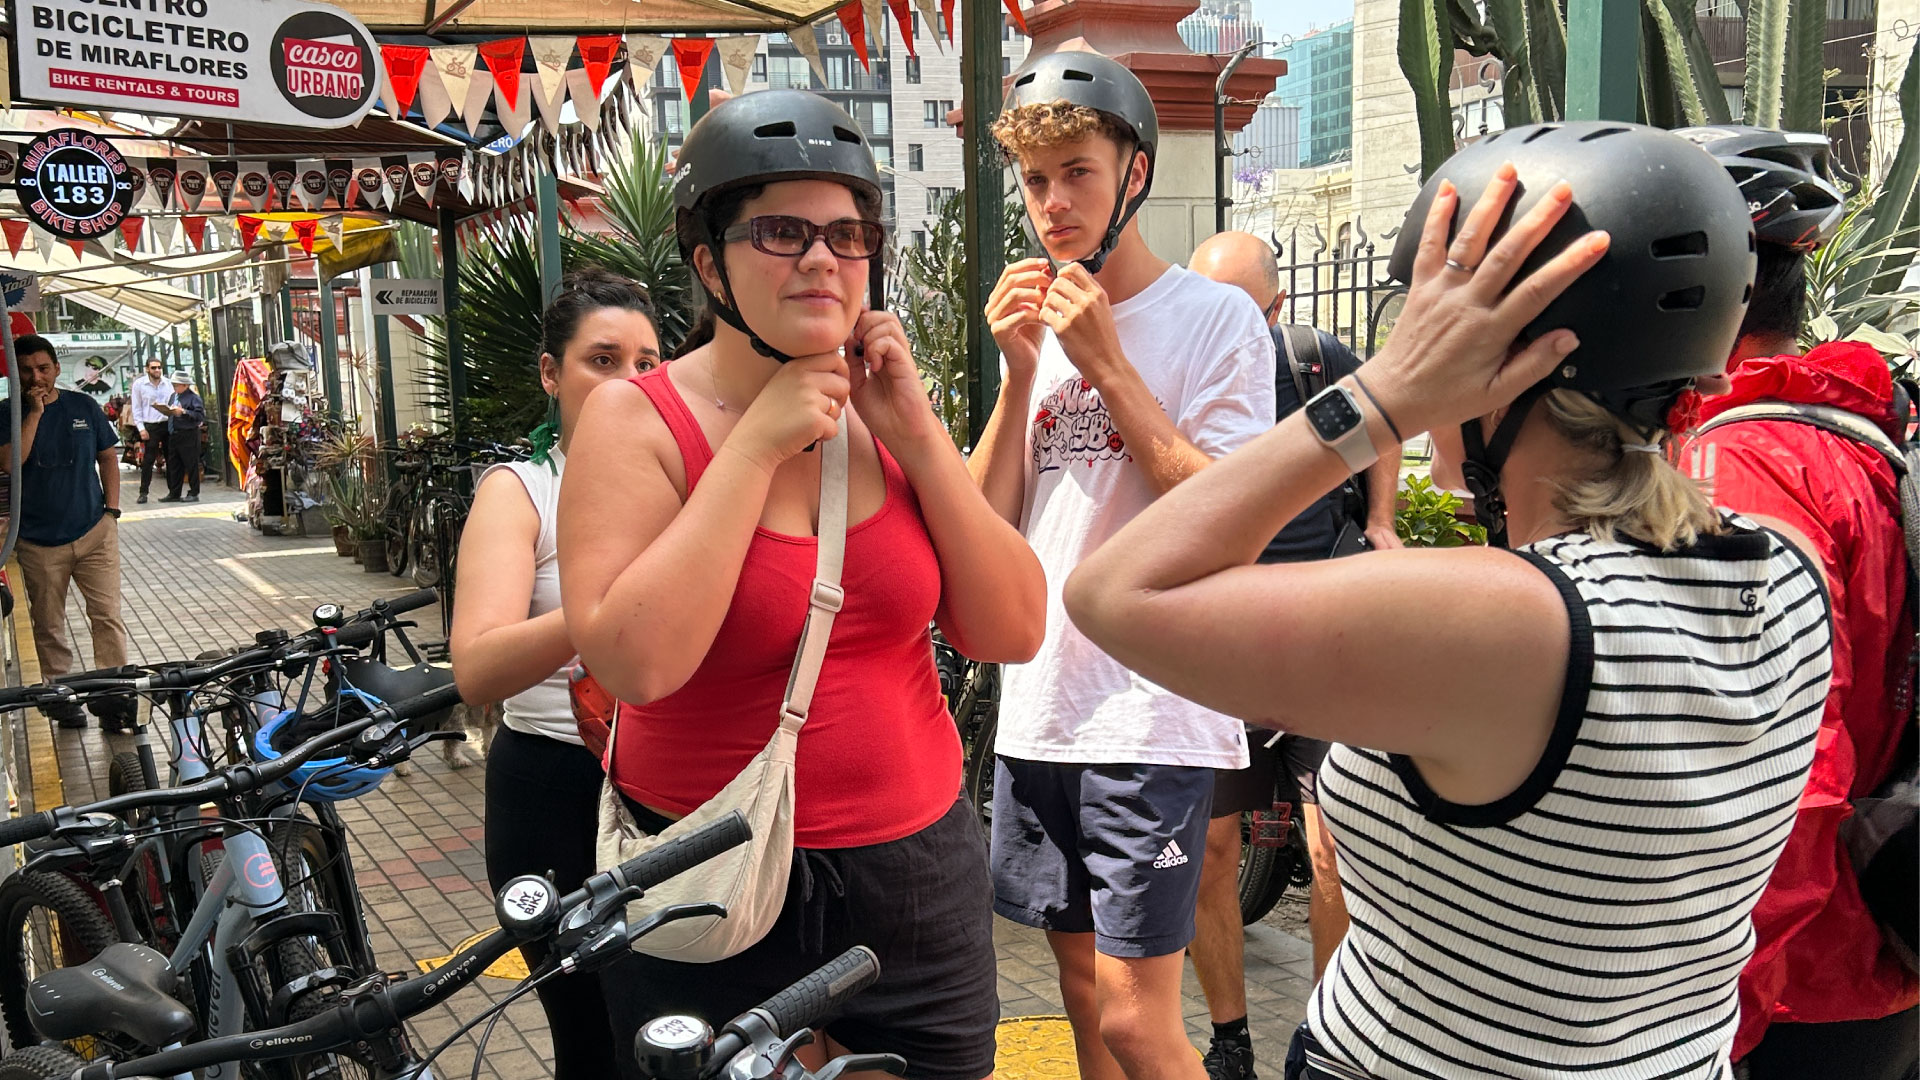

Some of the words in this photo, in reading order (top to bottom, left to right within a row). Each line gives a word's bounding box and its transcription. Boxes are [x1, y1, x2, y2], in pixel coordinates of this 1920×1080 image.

[32, 5, 249, 53] BICICLETERO
[37, 38, 72, 60] DE
[81, 43, 248, 80] MIRAFLORES
[289, 44, 358, 69] casco
[52, 73, 91, 87] BIKE
[95, 78, 165, 95] RENTALS
[170, 86, 181, 97] &
[185, 88, 236, 103] TOURS
[288, 68, 361, 99] URBANO
[22, 132, 127, 175] MIRAFLORES
[808, 138, 832, 147] BIKE
[46, 163, 108, 184] TALLER
[53, 185, 105, 205] 183
[30, 198, 76, 234] BIKE
[79, 201, 124, 235] SHOP
[395, 296, 404, 304] DE
[1153, 855, 1188, 869] adidas
[516, 891, 532, 910] MY
[524, 890, 545, 915] BIKE
[437, 955, 477, 986] elleven
[266, 1034, 313, 1046] elleven
